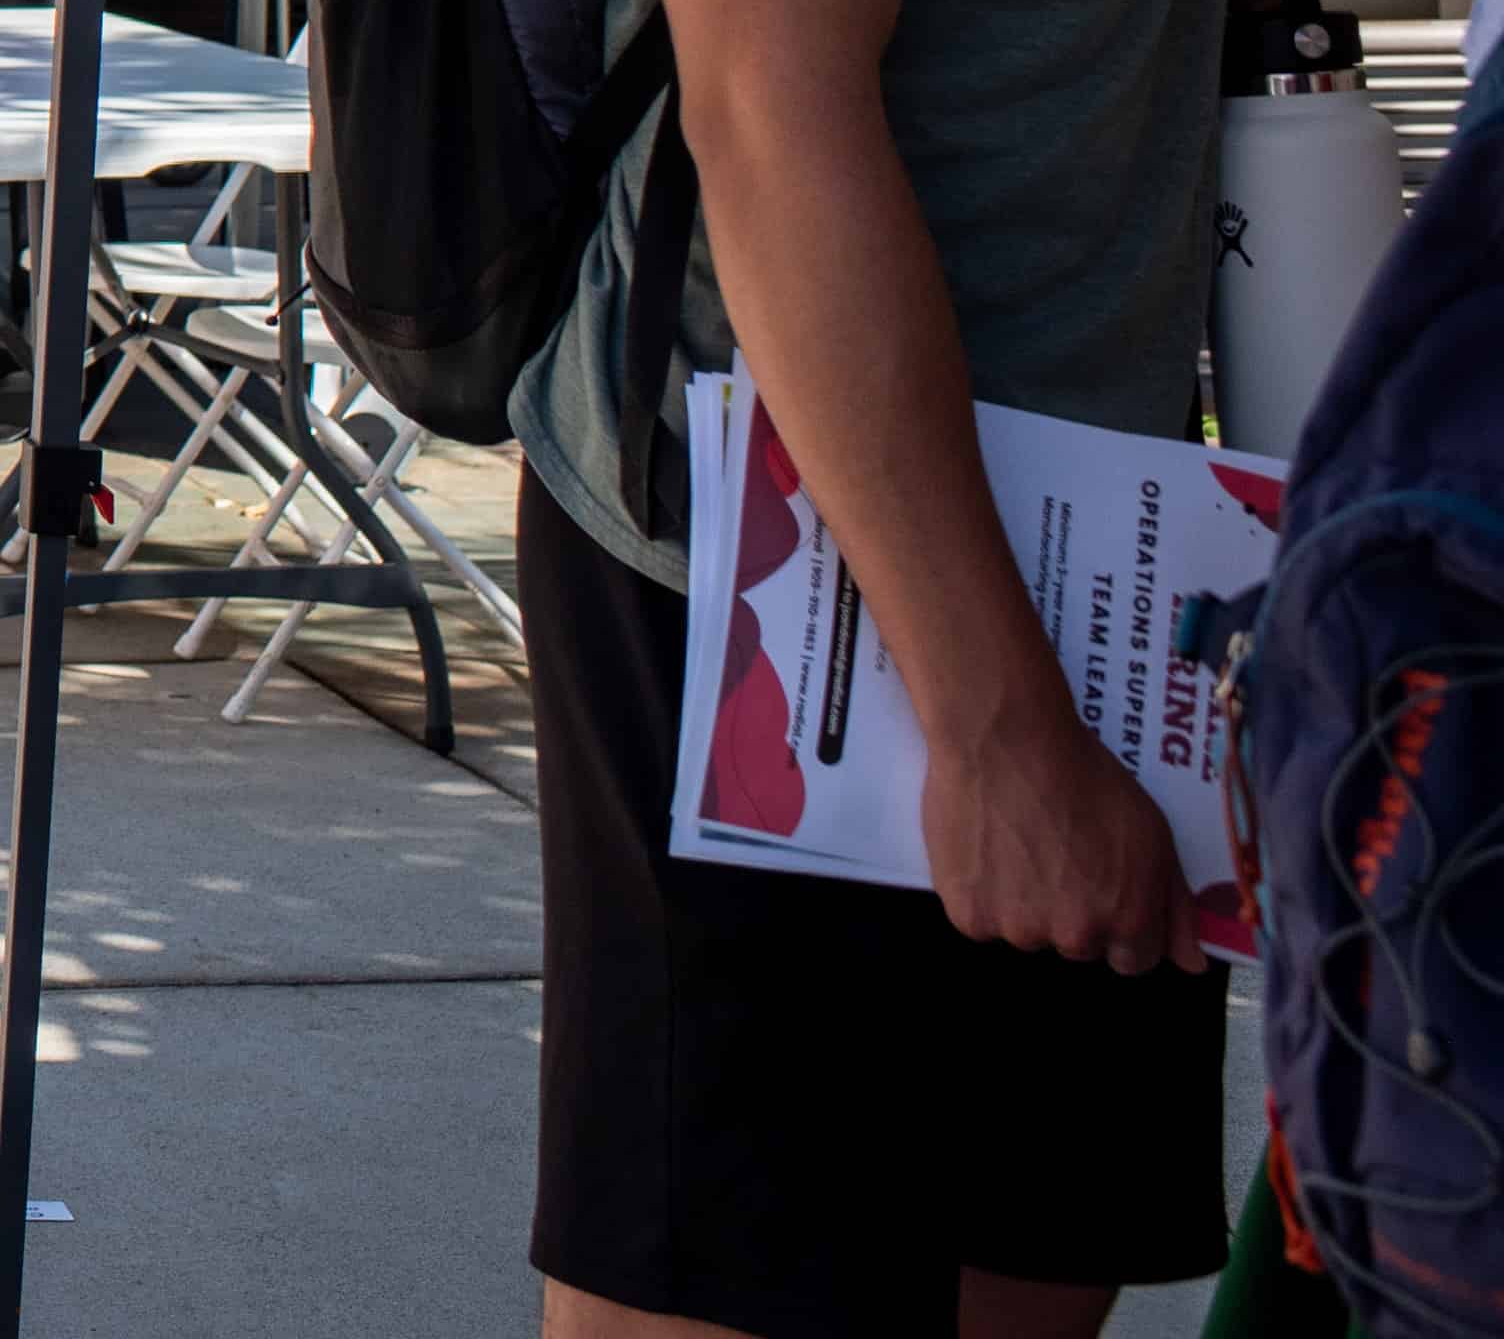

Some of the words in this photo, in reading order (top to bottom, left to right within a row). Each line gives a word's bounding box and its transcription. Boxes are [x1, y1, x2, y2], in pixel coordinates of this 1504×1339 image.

[1088, 573, 1114, 648] TEAM
[1130, 479, 1162, 653] OPERATIONS
[1119, 659, 1147, 773] SUPERV
